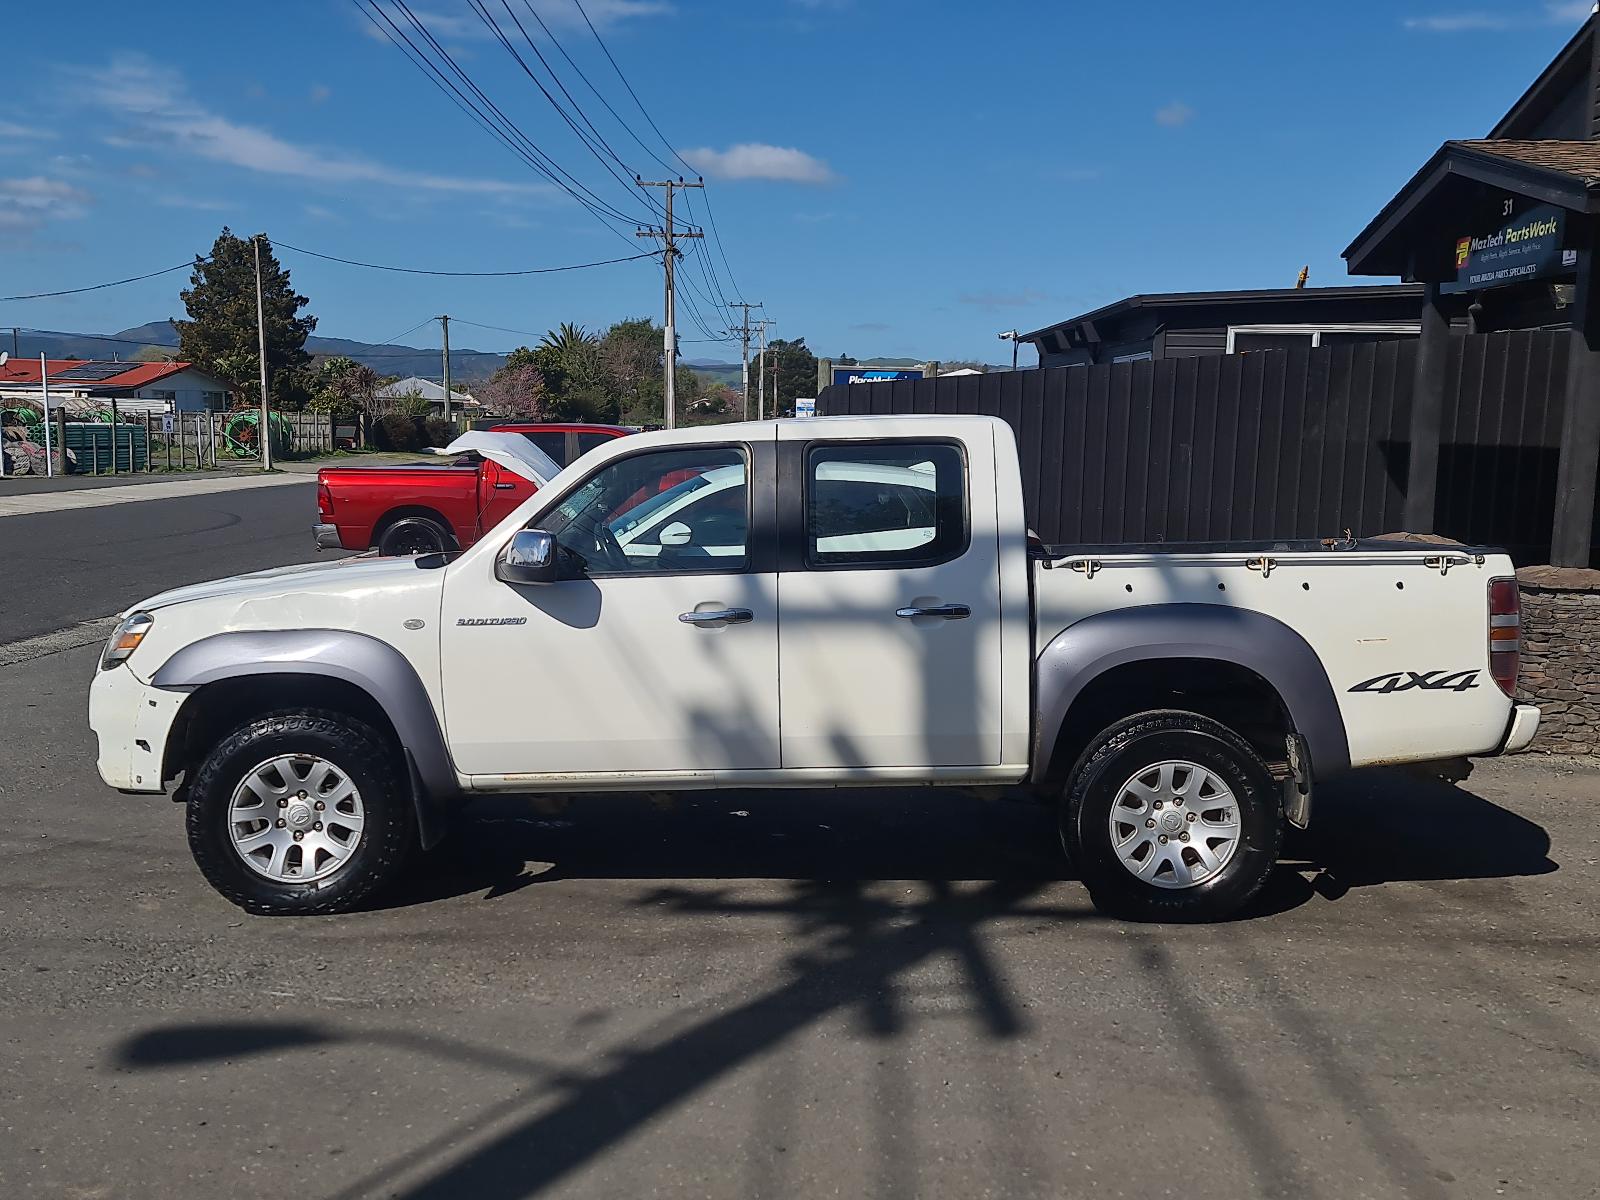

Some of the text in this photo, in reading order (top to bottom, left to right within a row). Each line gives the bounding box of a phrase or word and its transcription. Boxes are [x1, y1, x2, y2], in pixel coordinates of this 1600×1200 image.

[1502, 199, 1513, 216] 31
[1470, 231, 1504, 252] MazTech
[1509, 263, 1537, 277] SPECIALISTS
